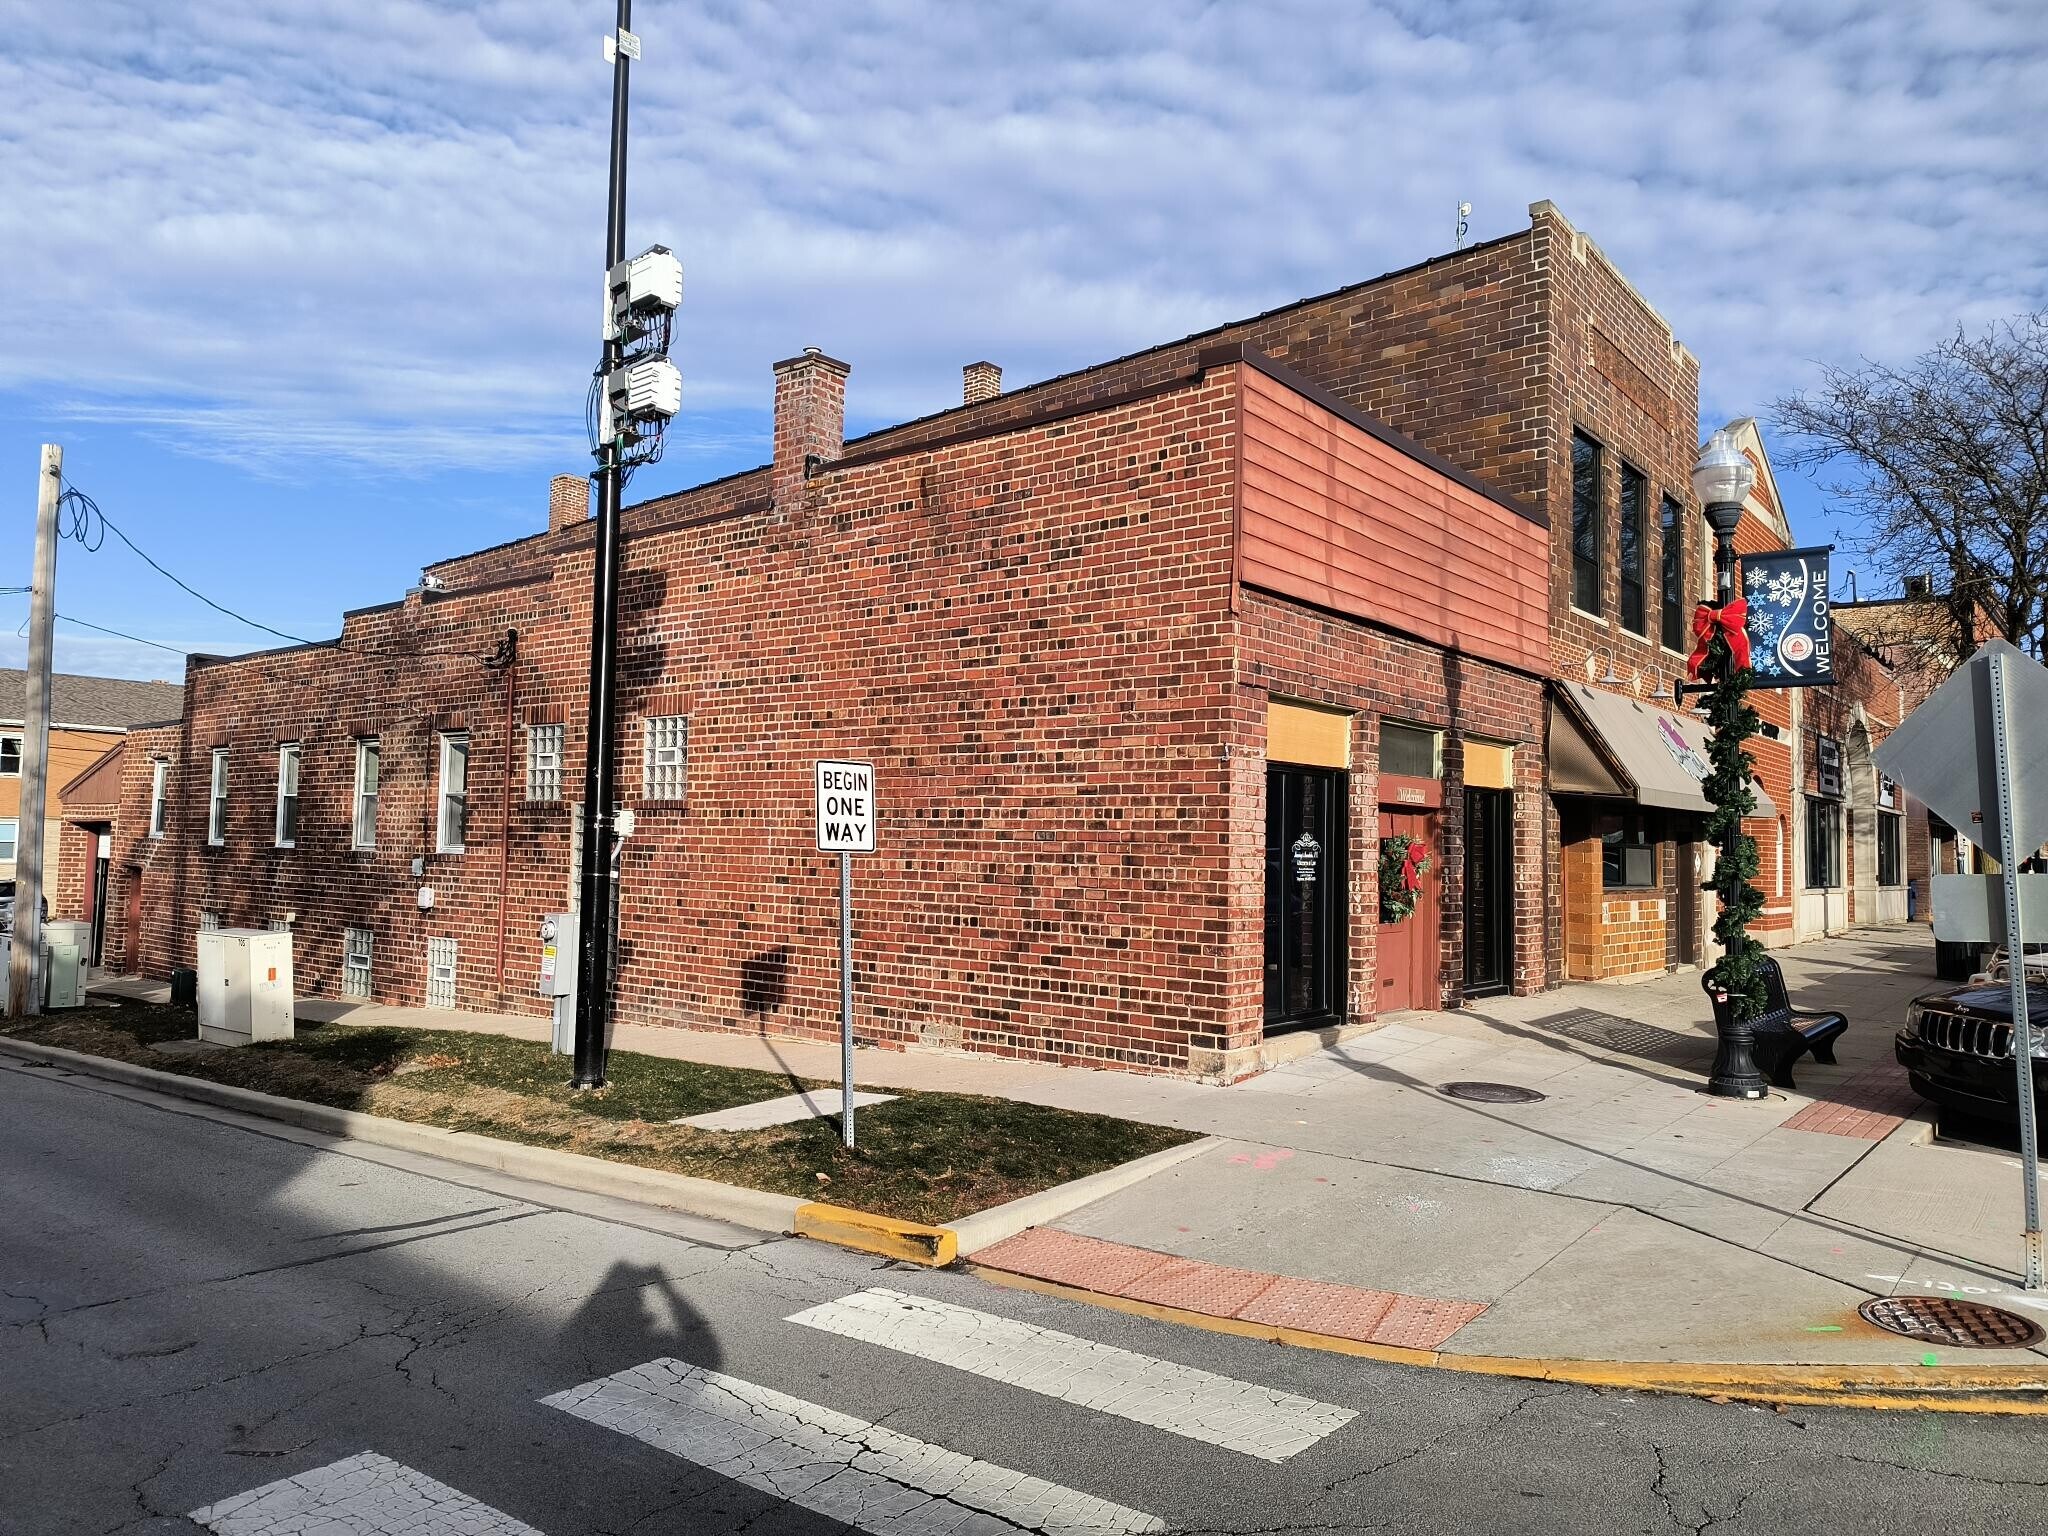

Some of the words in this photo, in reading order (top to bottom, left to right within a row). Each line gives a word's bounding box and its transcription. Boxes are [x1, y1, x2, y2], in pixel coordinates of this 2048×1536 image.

[1813, 570, 1830, 674] WELCOME
[823, 770, 868, 791] BEGIN
[826, 796, 865, 817] ONE
[825, 822, 867, 842] WAY
